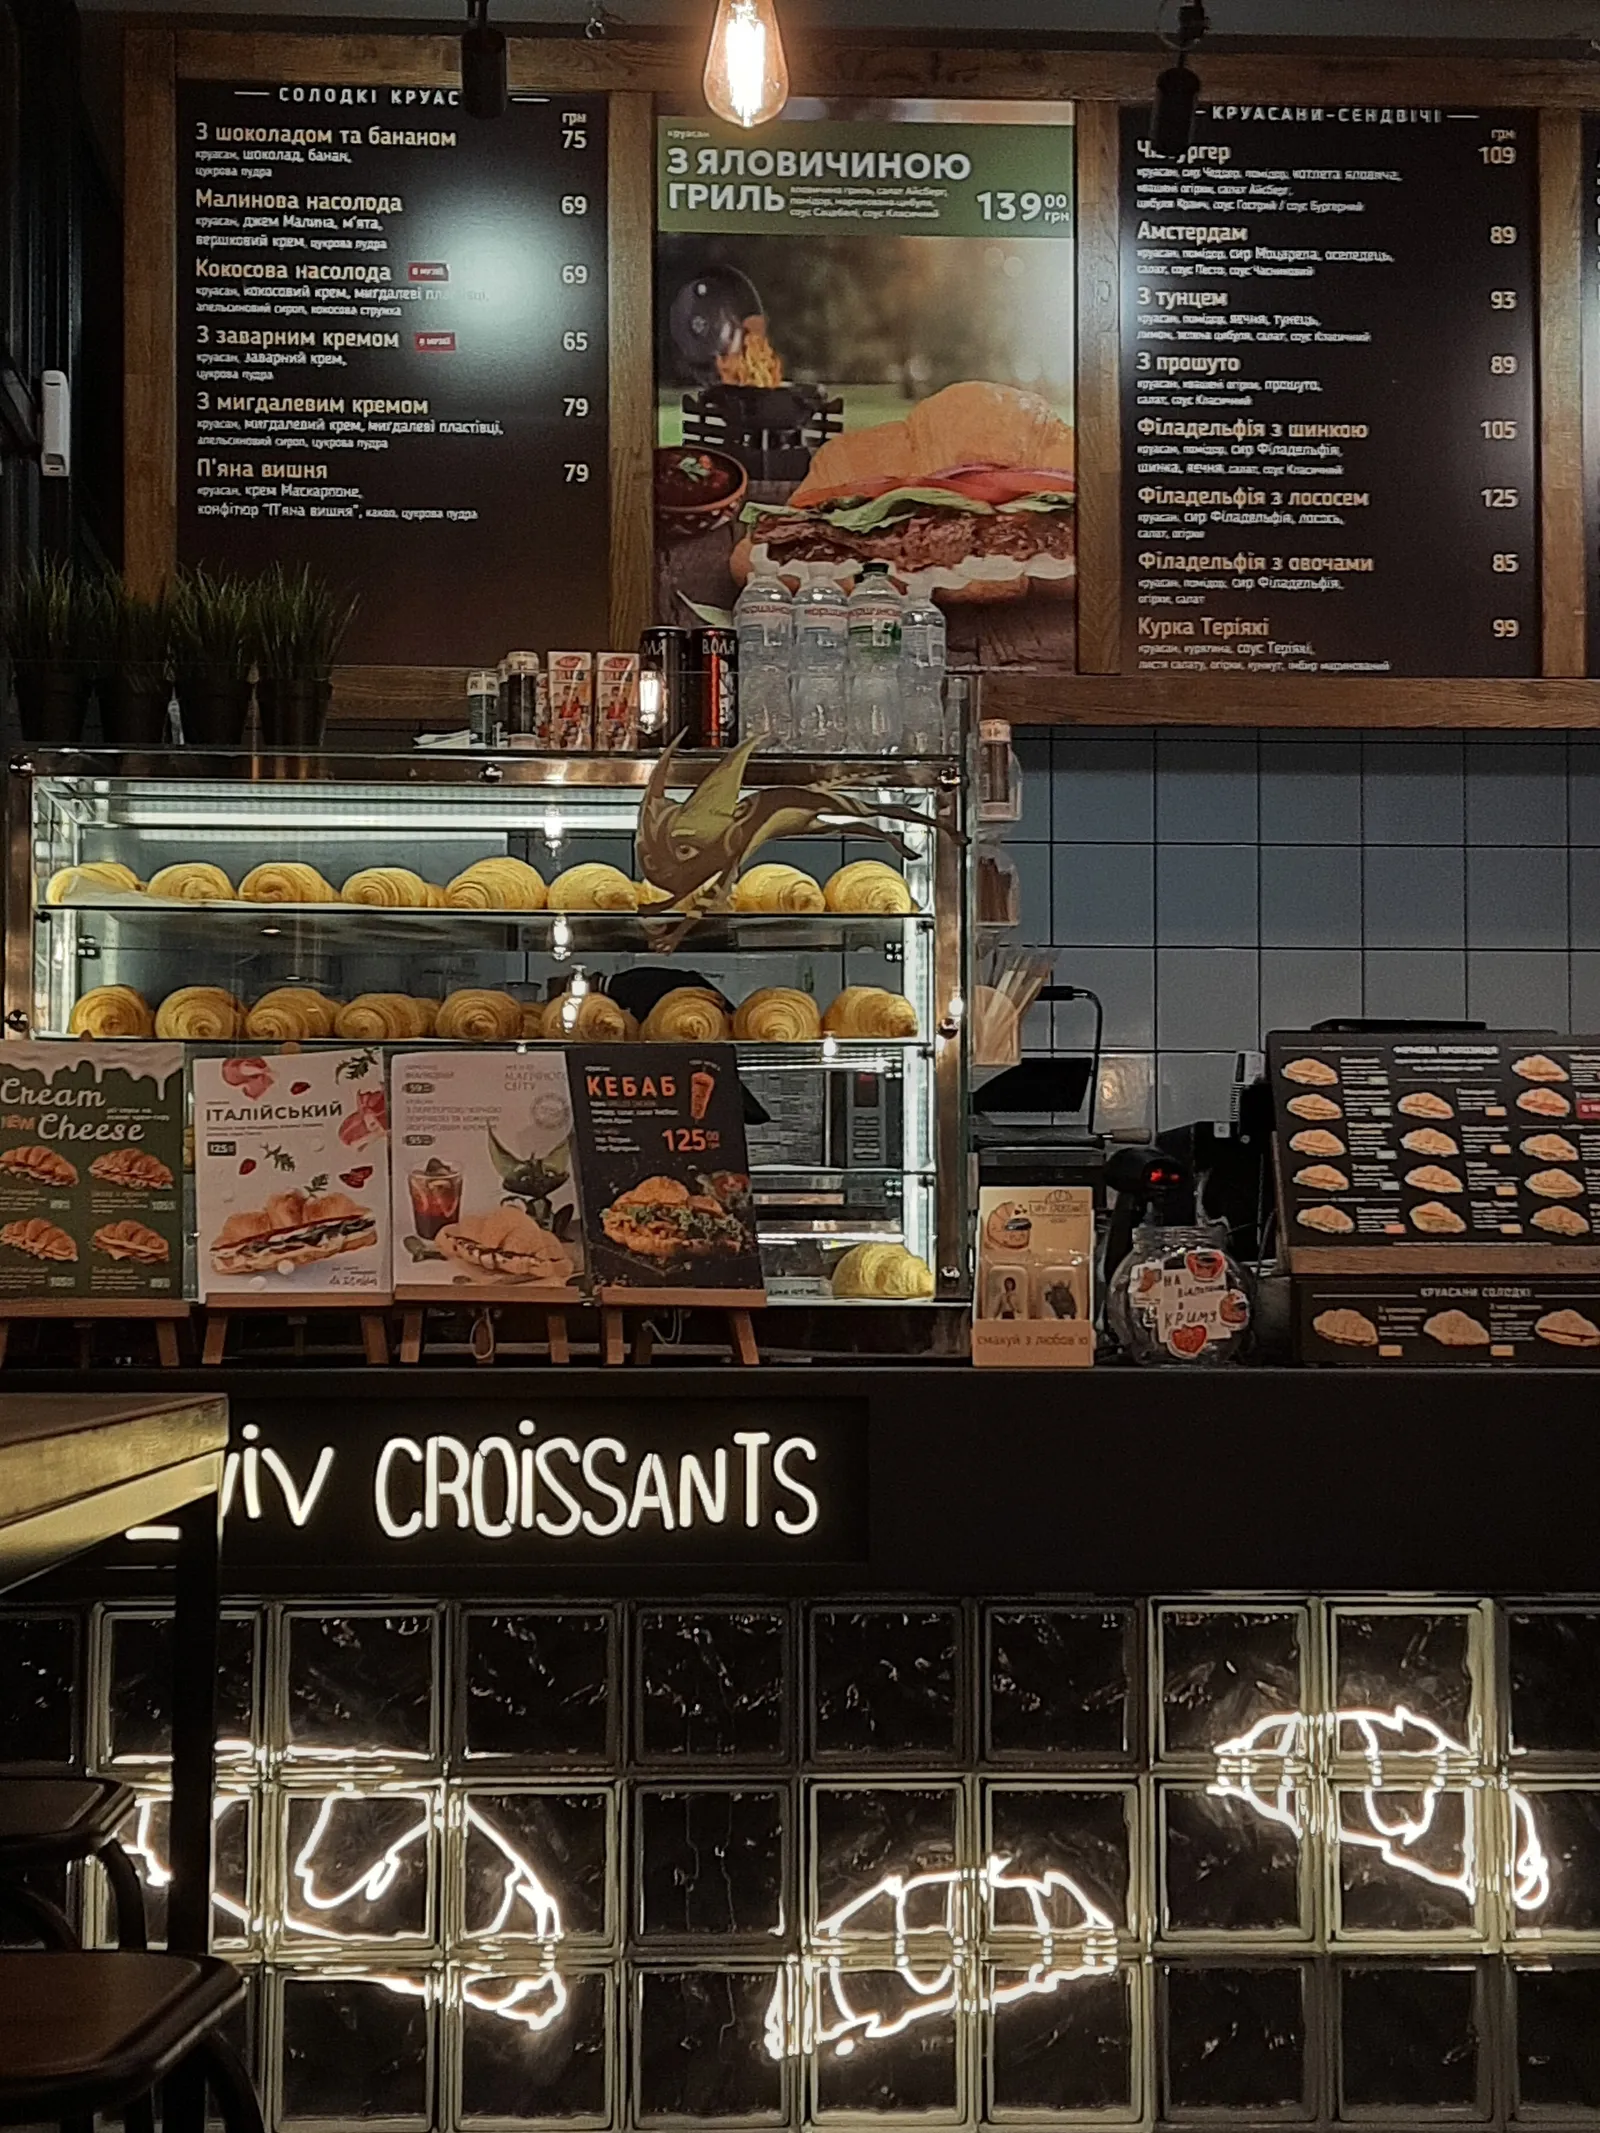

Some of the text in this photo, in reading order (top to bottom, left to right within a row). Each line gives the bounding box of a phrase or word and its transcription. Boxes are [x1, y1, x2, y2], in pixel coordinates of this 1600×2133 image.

[279, 87, 377, 105] СОЛОДКІ
[1212, 105, 1440, 125] КРУАСАНИ-СЕНДВІЧІ
[196, 122, 456, 147] З шоколадом та бананом
[561, 130, 587, 149] 75
[667, 147, 972, 181] З ЯЛОВИЧИНОЮ
[1477, 145, 1516, 165] 109
[195, 188, 403, 215] Малинова насолода
[561, 195, 587, 215] 69
[668, 182, 786, 212] ГРИЛЬ
[976, 191, 1042, 222] 139
[1044, 211, 1070, 225] грн
[1137, 221, 1248, 246] Амстердам
[1490, 225, 1517, 245] 89
[195, 258, 289, 279] Кокосова
[295, 264, 392, 284] насолода
[562, 265, 587, 284] 69
[1137, 287, 1228, 310] З тунцем
[1490, 290, 1517, 310] 93
[196, 325, 210, 344] З
[215, 329, 316, 348] заварним
[322, 332, 399, 350] кремом
[563, 331, 588, 351] 65
[1136, 352, 1241, 376] З прошуто
[1490, 355, 1517, 374] 89
[197, 391, 428, 418] З мигдалевим кремом
[563, 397, 589, 417] 79
[1137, 417, 1368, 442] Філадельфія з шинкою
[1480, 420, 1517, 439] 105
[197, 457, 328, 479] П'яна вишня
[564, 463, 589, 483] 79
[1137, 485, 1369, 510] Філадельфія з лососем
[1481, 488, 1518, 508] 125
[1138, 551, 1374, 575] Філадельфія з овочами
[1492, 553, 1519, 573] 85
[1138, 616, 1270, 640] Курка Теріякі
[1493, 619, 1519, 638] 99
[702, 637, 736, 657] ВОЛЯ
[1, 1078, 106, 1108] Cream
[587, 1075, 677, 1098] КЕБАБ
[206, 1100, 343, 1122] ІТАЛІЙСЬКИЙ
[38, 1113, 145, 1142] Cheese
[662, 1128, 706, 1151] 125
